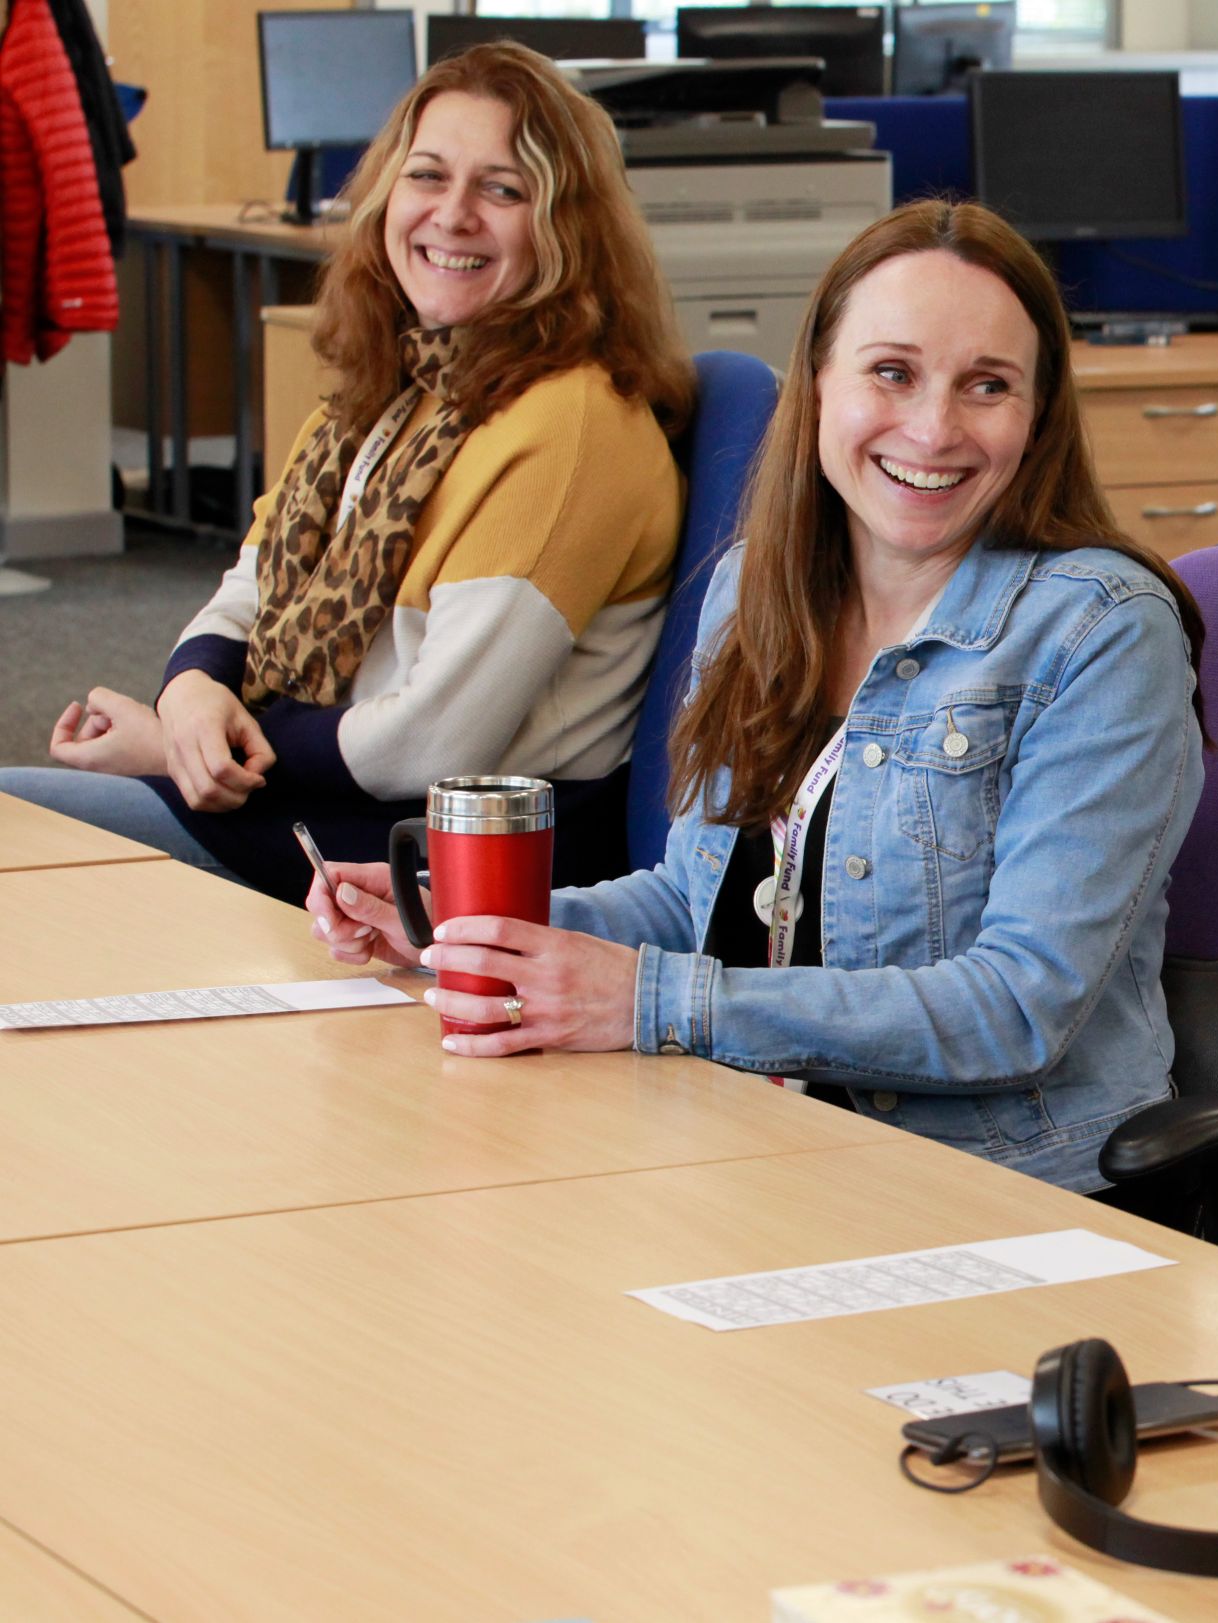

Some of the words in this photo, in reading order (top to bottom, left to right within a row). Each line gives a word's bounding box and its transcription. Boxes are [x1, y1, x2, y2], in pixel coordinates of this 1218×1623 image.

[824, 737, 845, 766] mily
[807, 766, 828, 794] Fund
[787, 822, 802, 860] Family
[781, 861, 796, 891] Fund
[776, 925, 788, 966] Family
